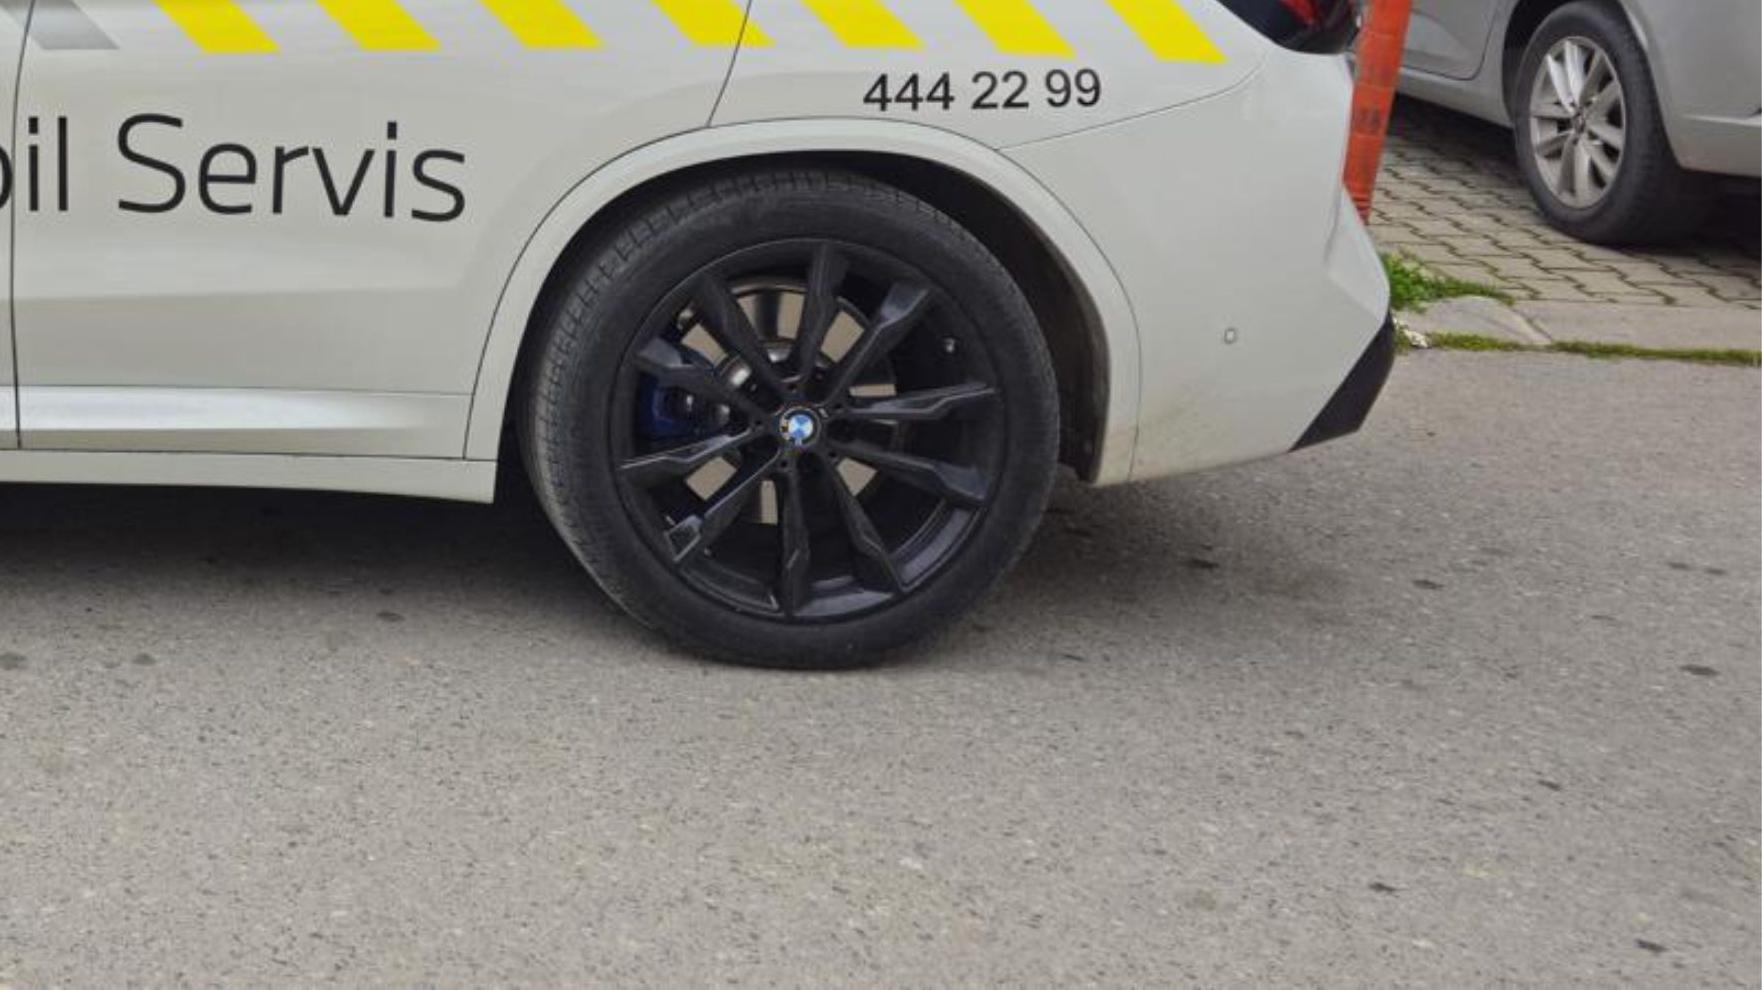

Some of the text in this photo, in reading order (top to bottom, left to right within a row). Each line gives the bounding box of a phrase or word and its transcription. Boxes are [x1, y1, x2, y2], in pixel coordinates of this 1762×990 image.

[863, 68, 1102, 111] 444 22 99
[116, 112, 468, 223] Servis
